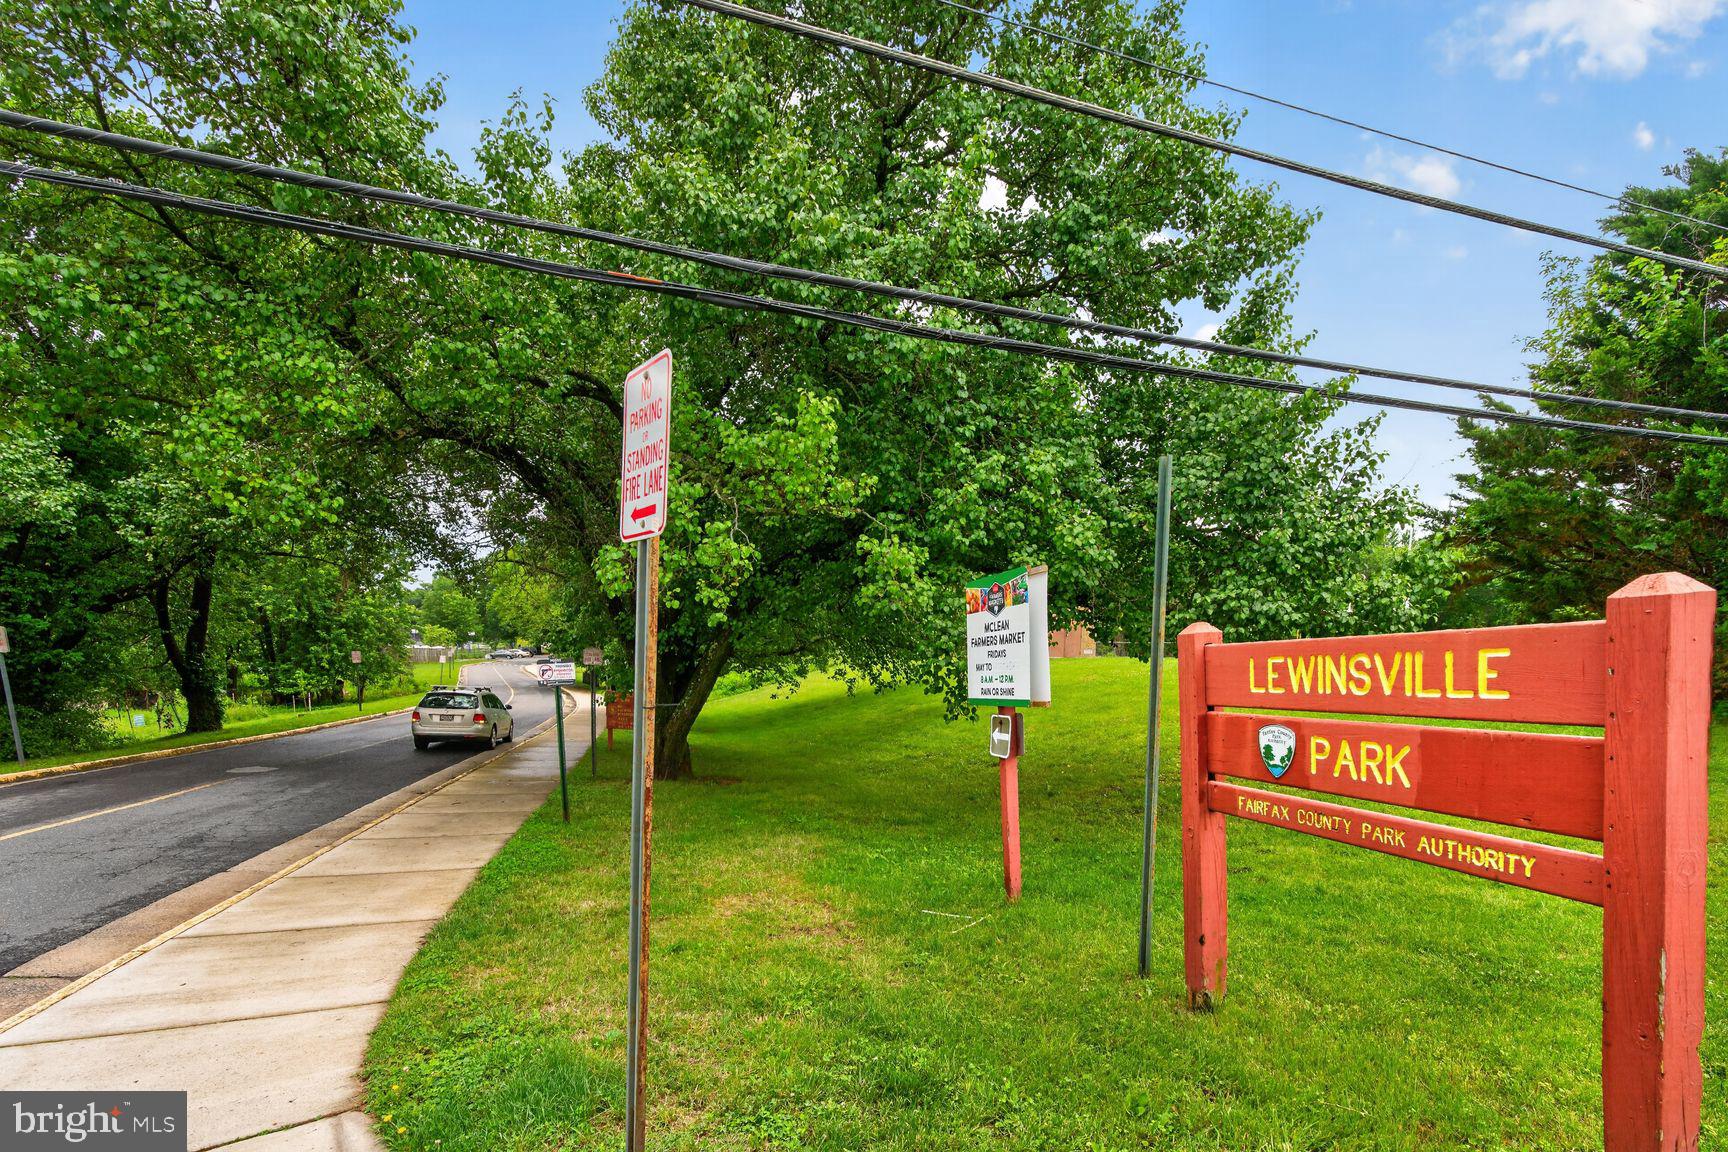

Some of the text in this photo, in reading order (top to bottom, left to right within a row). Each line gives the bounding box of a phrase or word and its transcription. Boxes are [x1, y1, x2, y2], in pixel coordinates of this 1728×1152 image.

[641, 379, 652, 401] NO
[630, 398, 663, 433] PARKING
[642, 430, 649, 443] OR
[627, 439, 664, 474] STANDING
[625, 465, 663, 503] FIRE LANE
[984, 619, 1010, 633] MCLEAN
[971, 632, 1025, 648] FARMERS MARKET
[988, 649, 1006, 658] FRIDAYS
[975, 663, 992, 671] MAY TO
[1249, 647, 1512, 700] LEWINSVILLE
[999, 675, 1004, 683] 12
[981, 687, 1015, 696] RAIN OR SHINE
[1310, 735, 1411, 789] PARK
[1238, 795, 1537, 878] FAIRFAX COUNTY PARK AUTHORITY
